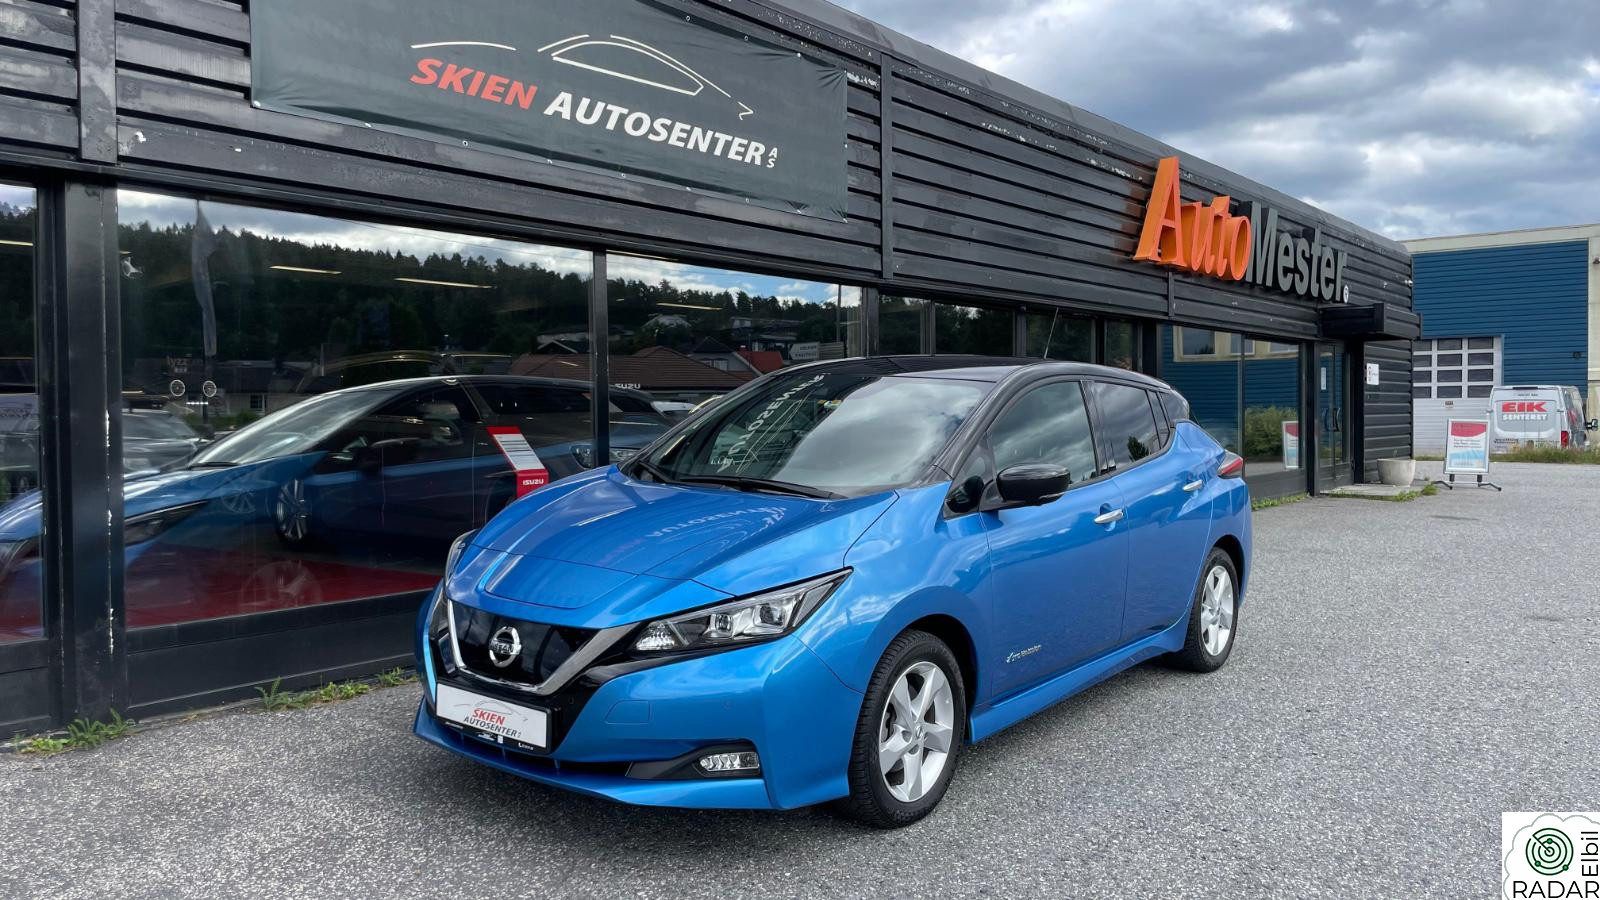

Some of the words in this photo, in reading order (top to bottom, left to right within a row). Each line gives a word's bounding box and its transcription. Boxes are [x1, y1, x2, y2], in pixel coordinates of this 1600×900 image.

[410, 58, 537, 110] SKIEN
[543, 91, 766, 165] AUTOSENTER
[1501, 402, 1547, 413] EIK
[1502, 413, 1547, 421] SENTERET
[472, 707, 506, 725] SKIEN
[463, 716, 519, 738] AUTOSENTER
